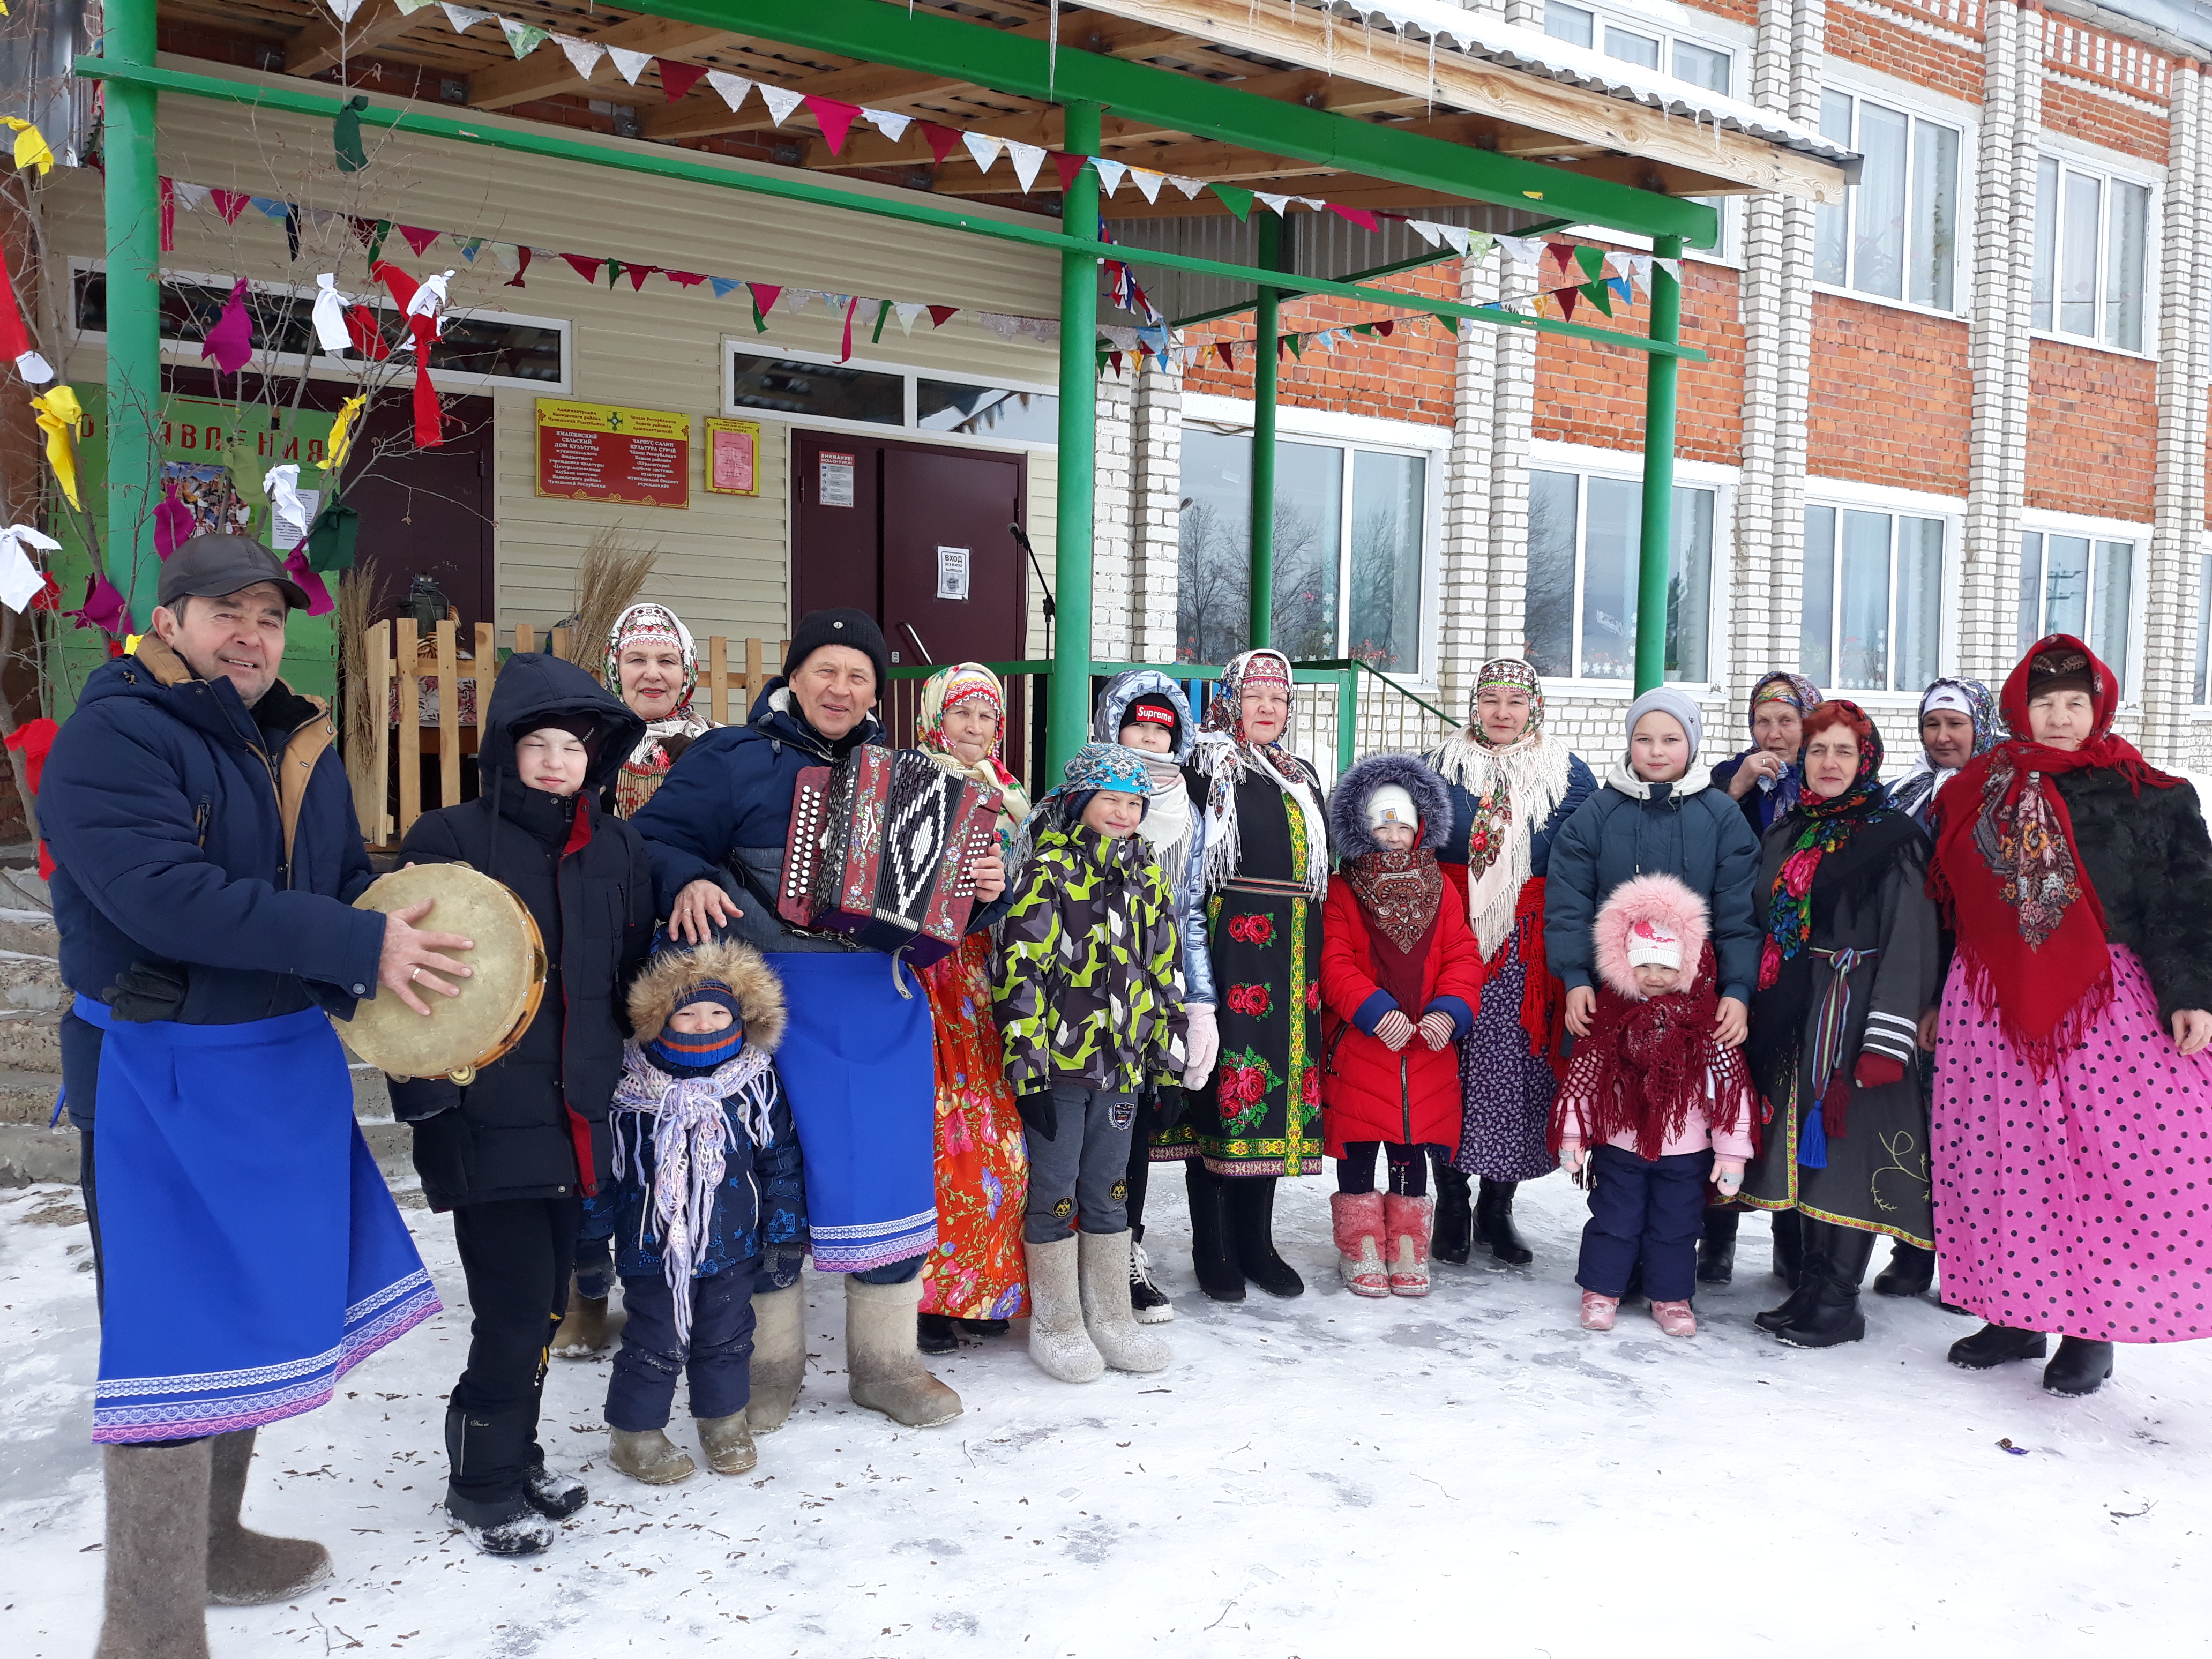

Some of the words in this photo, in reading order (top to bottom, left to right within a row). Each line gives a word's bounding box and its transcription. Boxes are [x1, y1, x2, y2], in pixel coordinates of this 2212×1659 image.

[557, 407, 596, 415] Администрация
[81, 413, 324, 462] ОЯВЛНИЯ
[556, 430, 597, 439] ЯМАШЕВСКИЙ
[945, 555, 963, 564] ВХОД
[1138, 707, 1172, 722] Supreme
